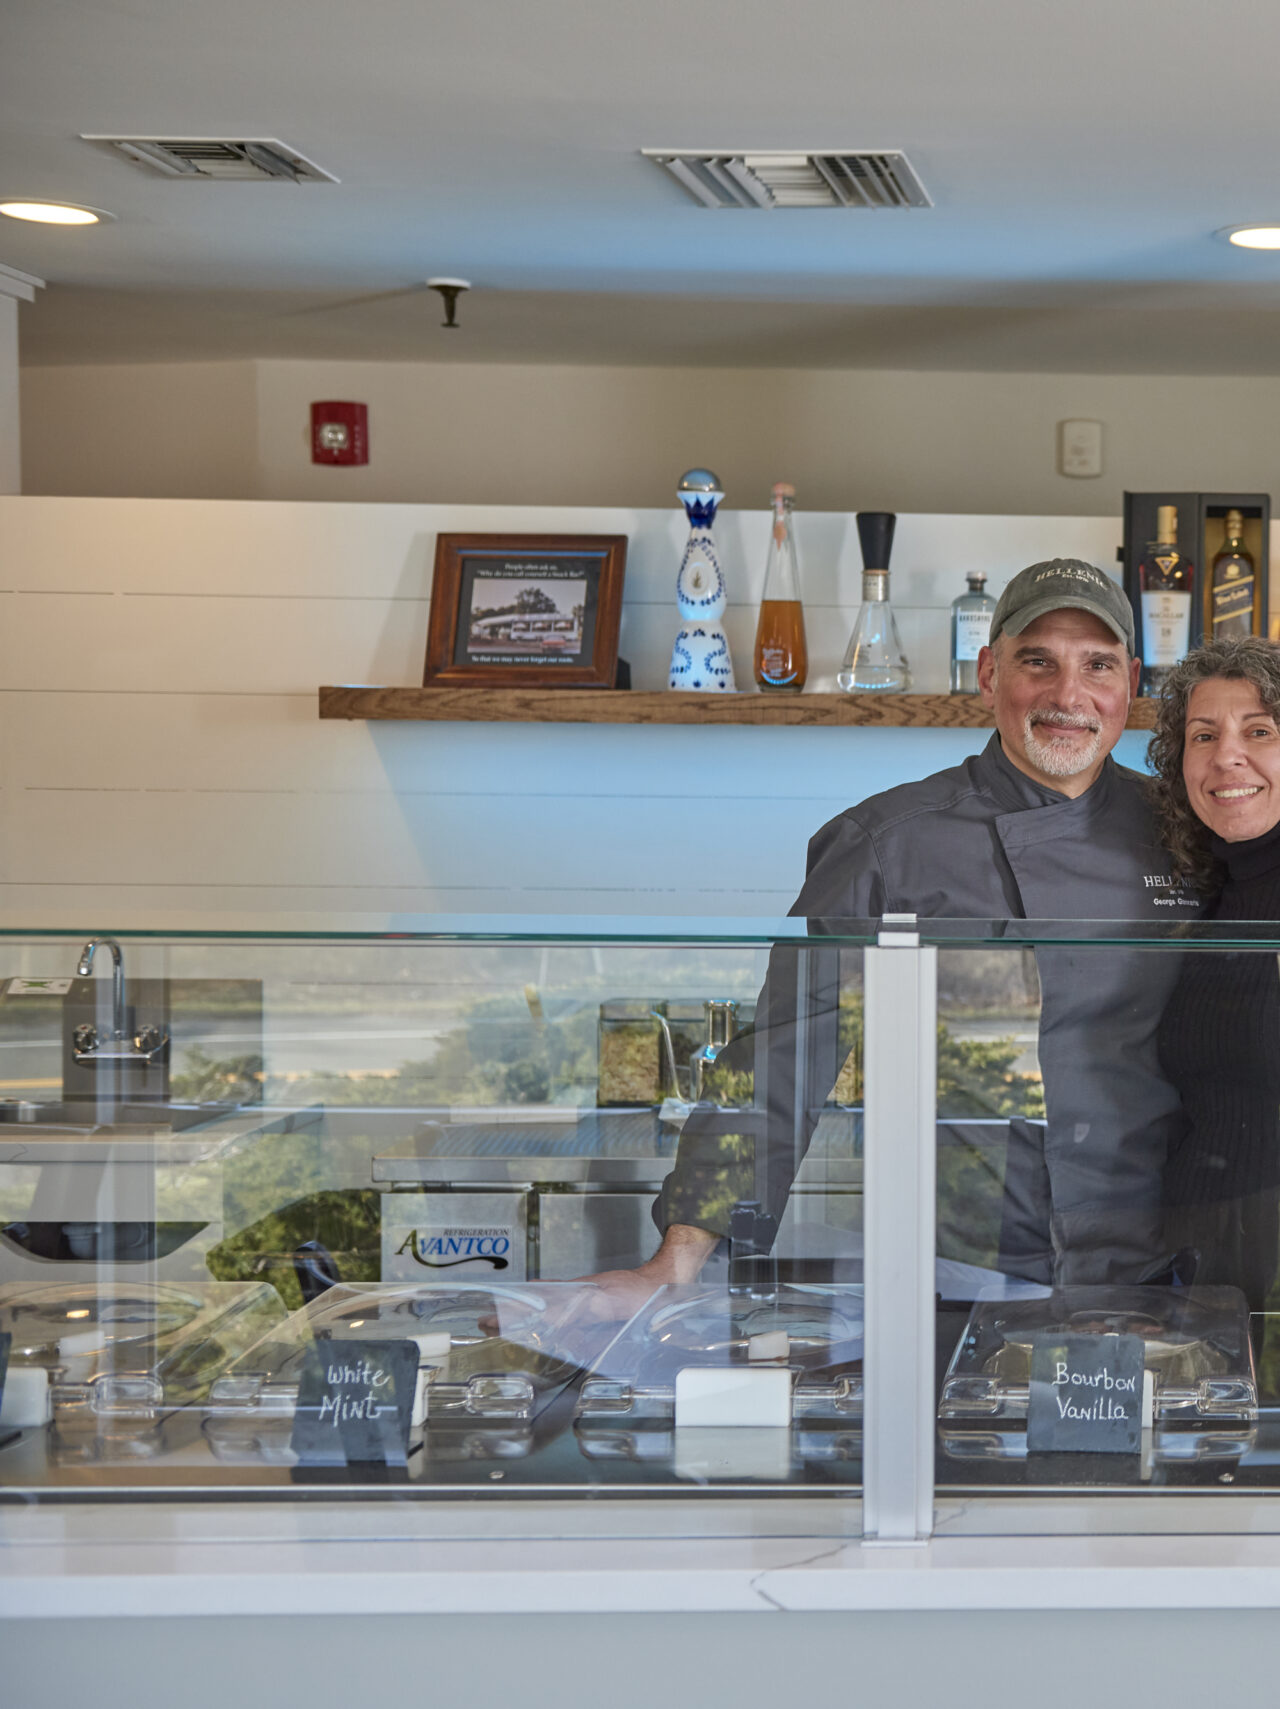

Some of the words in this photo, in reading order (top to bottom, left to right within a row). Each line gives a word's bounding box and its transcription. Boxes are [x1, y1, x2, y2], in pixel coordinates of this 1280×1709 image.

[1034, 568, 1108, 591] HELLENIC
[1153, 898, 1176, 906] George
[394, 1229, 510, 1258] AVANTCO
[443, 1228, 509, 1236] REFRIGERATION
[1051, 1362, 1136, 1392] Bourbon
[1056, 1396, 1129, 1420] Vanilla
